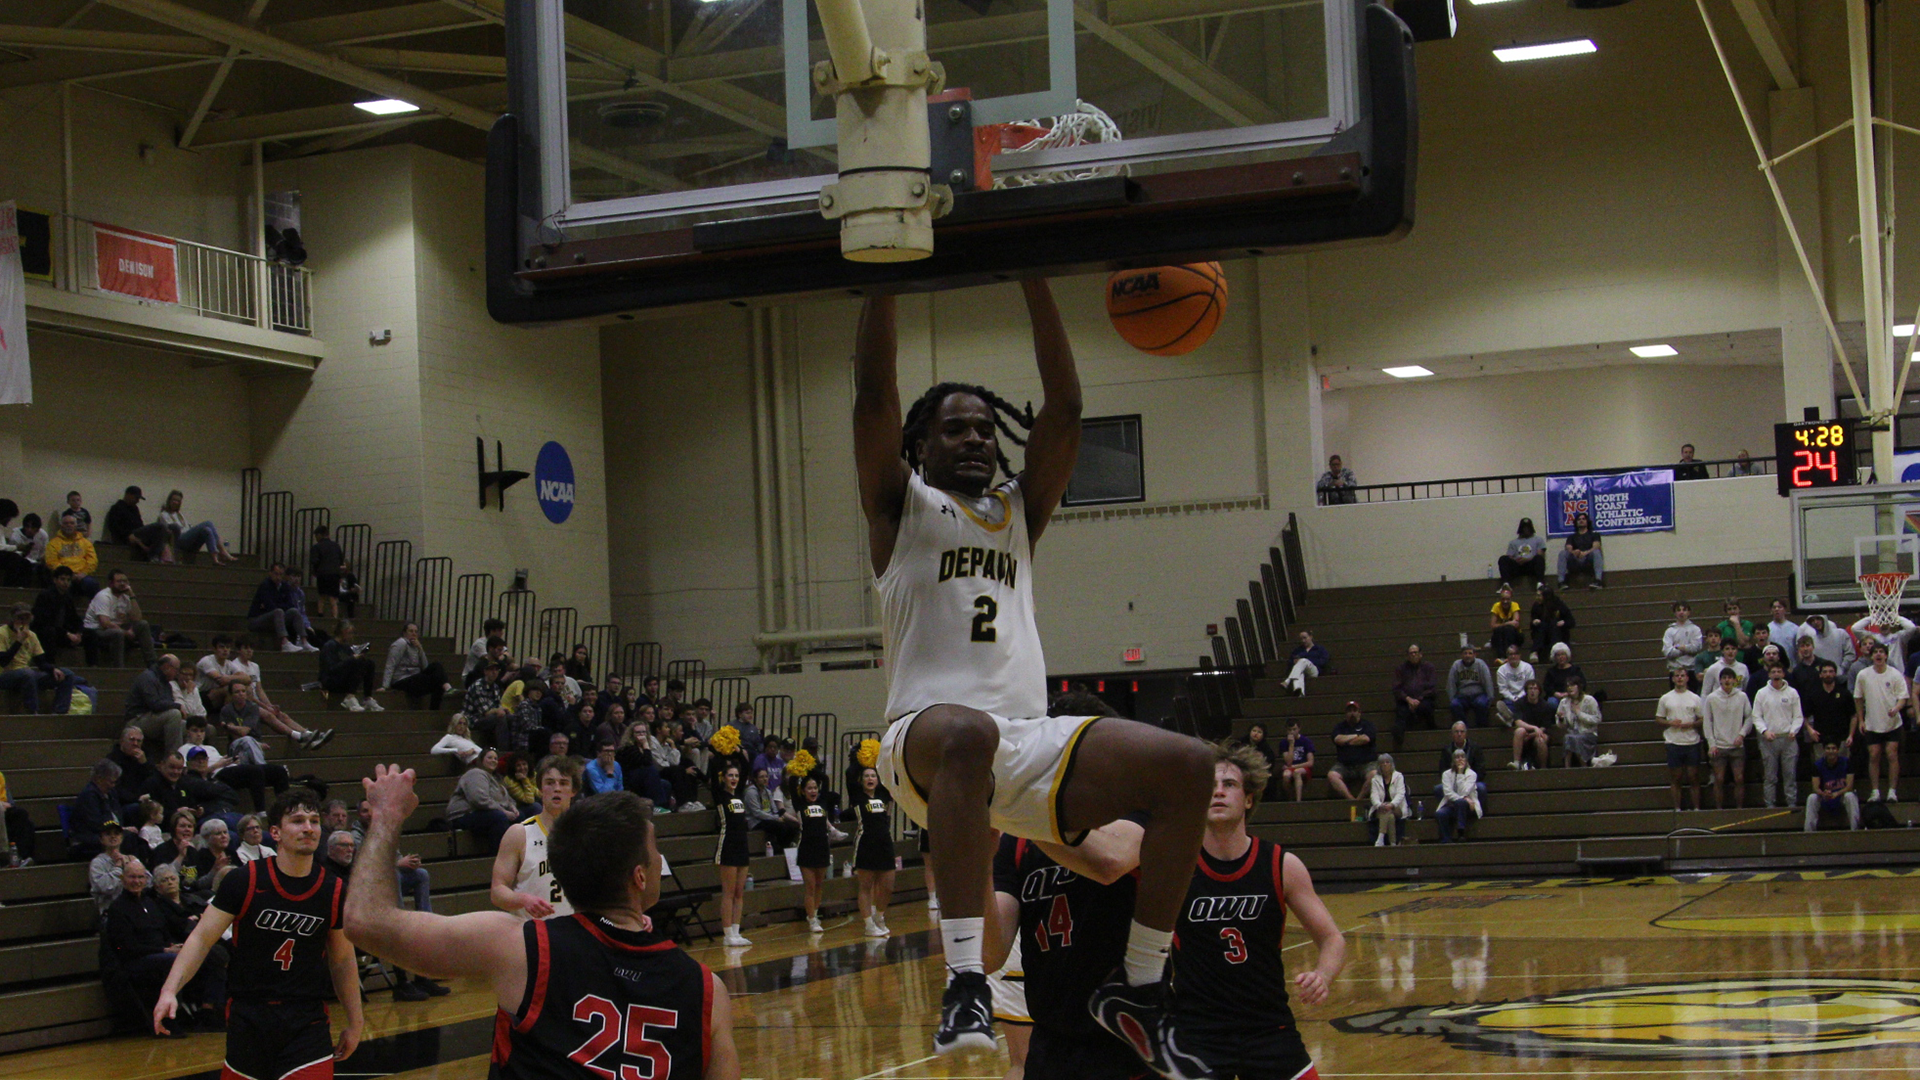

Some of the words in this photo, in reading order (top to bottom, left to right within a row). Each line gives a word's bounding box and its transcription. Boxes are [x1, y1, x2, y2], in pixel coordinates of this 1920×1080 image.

[118, 258, 154, 279] DENISON
[1111, 272, 1159, 299] NCAA
[1794, 424, 1844, 447] 4:28
[1792, 449, 1837, 487] 24
[540, 479, 574, 504] NCAA
[1594, 492, 1629, 503] NORTH
[1564, 500, 1588, 514] NC
[1594, 501, 1629, 511] COAST
[1595, 508, 1644, 520] ATHLETIC
[1595, 515, 1662, 528] CONFERENCE
[971, 596, 997, 642] 2
[1188, 895, 1268, 922] OWU
[255, 908, 325, 937] OWU
[273, 938, 296, 971] 4
[1220, 927, 1248, 964] 3
[567, 993, 679, 1080] 25
